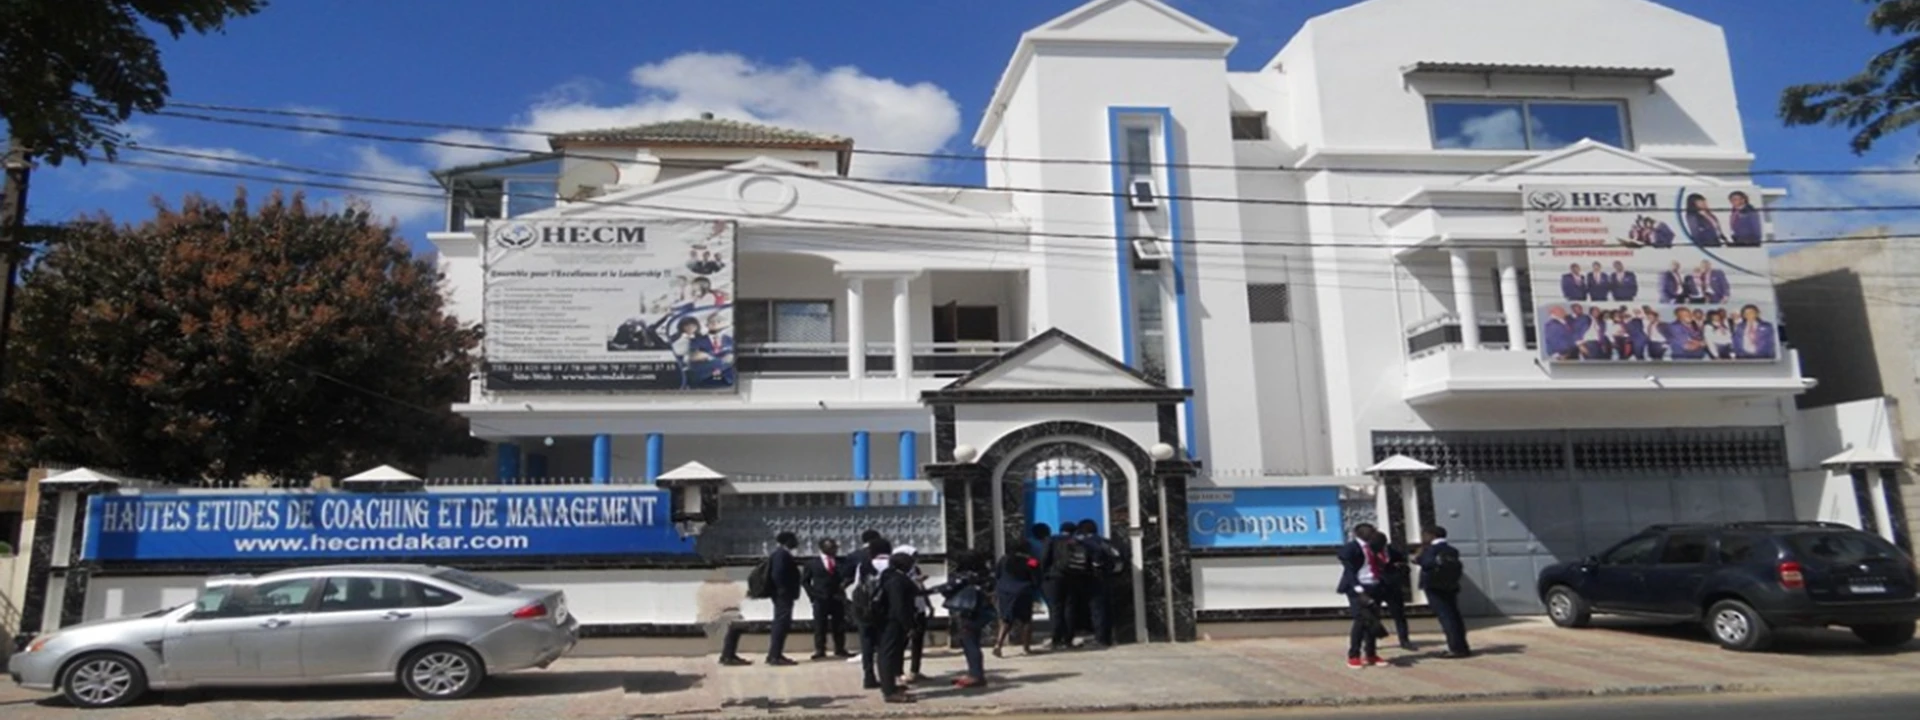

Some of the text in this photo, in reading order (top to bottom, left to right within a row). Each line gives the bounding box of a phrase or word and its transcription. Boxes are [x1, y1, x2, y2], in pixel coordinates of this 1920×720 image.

[1571, 192, 1658, 207] HECM
[542, 226, 647, 244] HECM
[530, 271, 549, 279] pour
[619, 269, 662, 279] Leadership
[561, 371, 656, 380] www.hecmdakar.com
[103, 496, 658, 532] HAUTES ETUDES DE COACHING ET DE MANAGEMENT
[1193, 508, 1309, 540] Campus
[234, 533, 529, 551] www.hecmdakar.com
